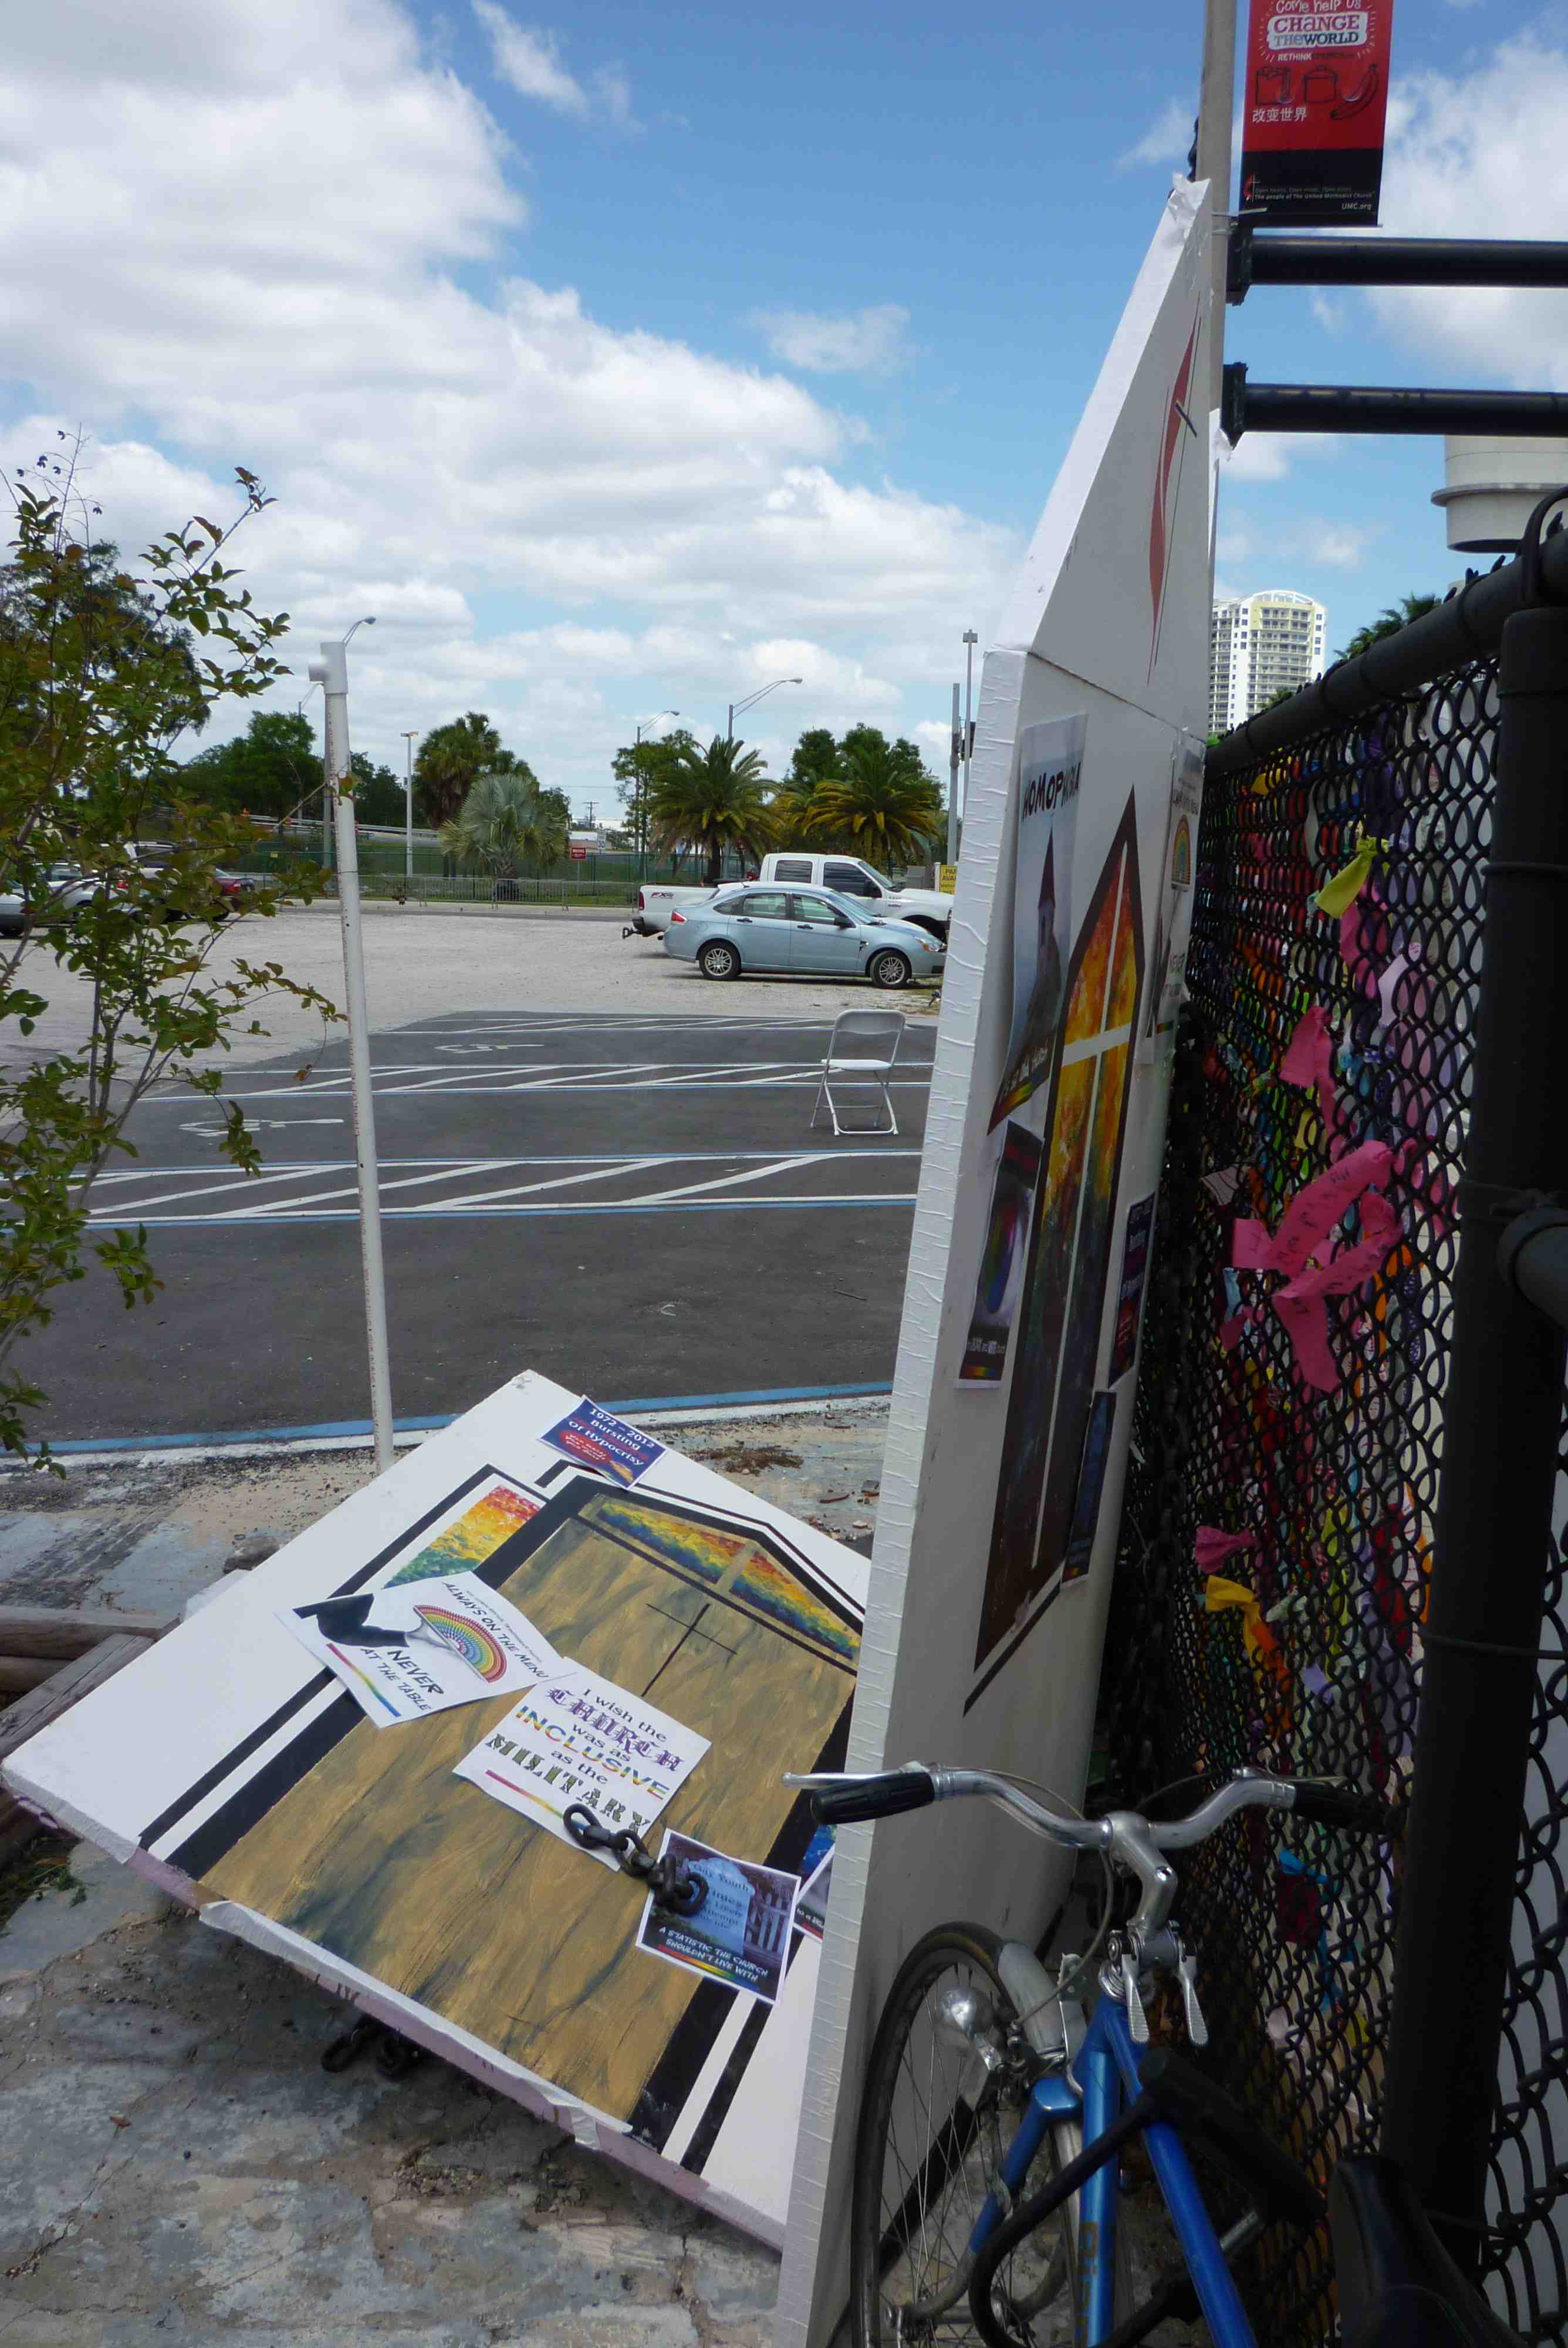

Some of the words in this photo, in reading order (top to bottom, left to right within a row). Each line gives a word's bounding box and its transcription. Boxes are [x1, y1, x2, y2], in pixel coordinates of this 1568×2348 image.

[1303, 32, 1359, 46] WORLD
[1252, 107, 1307, 123] 改变世界
[1341, 202, 1371, 211] UMC.org
[585, 1431, 644, 1465] Hypocrisy
[589, 1408, 616, 1426] 1972
[627, 1429, 655, 1449] 2012
[590, 1419, 641, 1450] Bursting
[441, 1582, 487, 1616] ALWAYS
[482, 1617, 501, 1632] ON
[499, 1634, 519, 1652] THE
[515, 1653, 550, 1678] MENU
[360, 1648, 382, 1660] AT
[377, 1662, 400, 1681] THE
[397, 1682, 432, 1711] TABLE
[387, 1649, 444, 1695] NEVER
[583, 1688, 592, 1697] I
[596, 1696, 634, 1723] wish
[638, 1721, 667, 1743] the
[515, 1705, 671, 1801] INCLUSIVE
[573, 1723, 605, 1749] was
[609, 1748, 631, 1763] as
[485, 1733, 651, 1834] MILITARY
[550, 1749, 573, 1765] as
[577, 1762, 609, 1785] the
[665, 1938, 714, 1962] SHOULDN'T
[714, 1958, 734, 1969] LIVE
[735, 1966, 758, 1982] WITH
[668, 1929, 713, 1952] STATISTIC
[715, 1948, 731, 1959] THE
[733, 1956, 769, 1977] CHURCH
